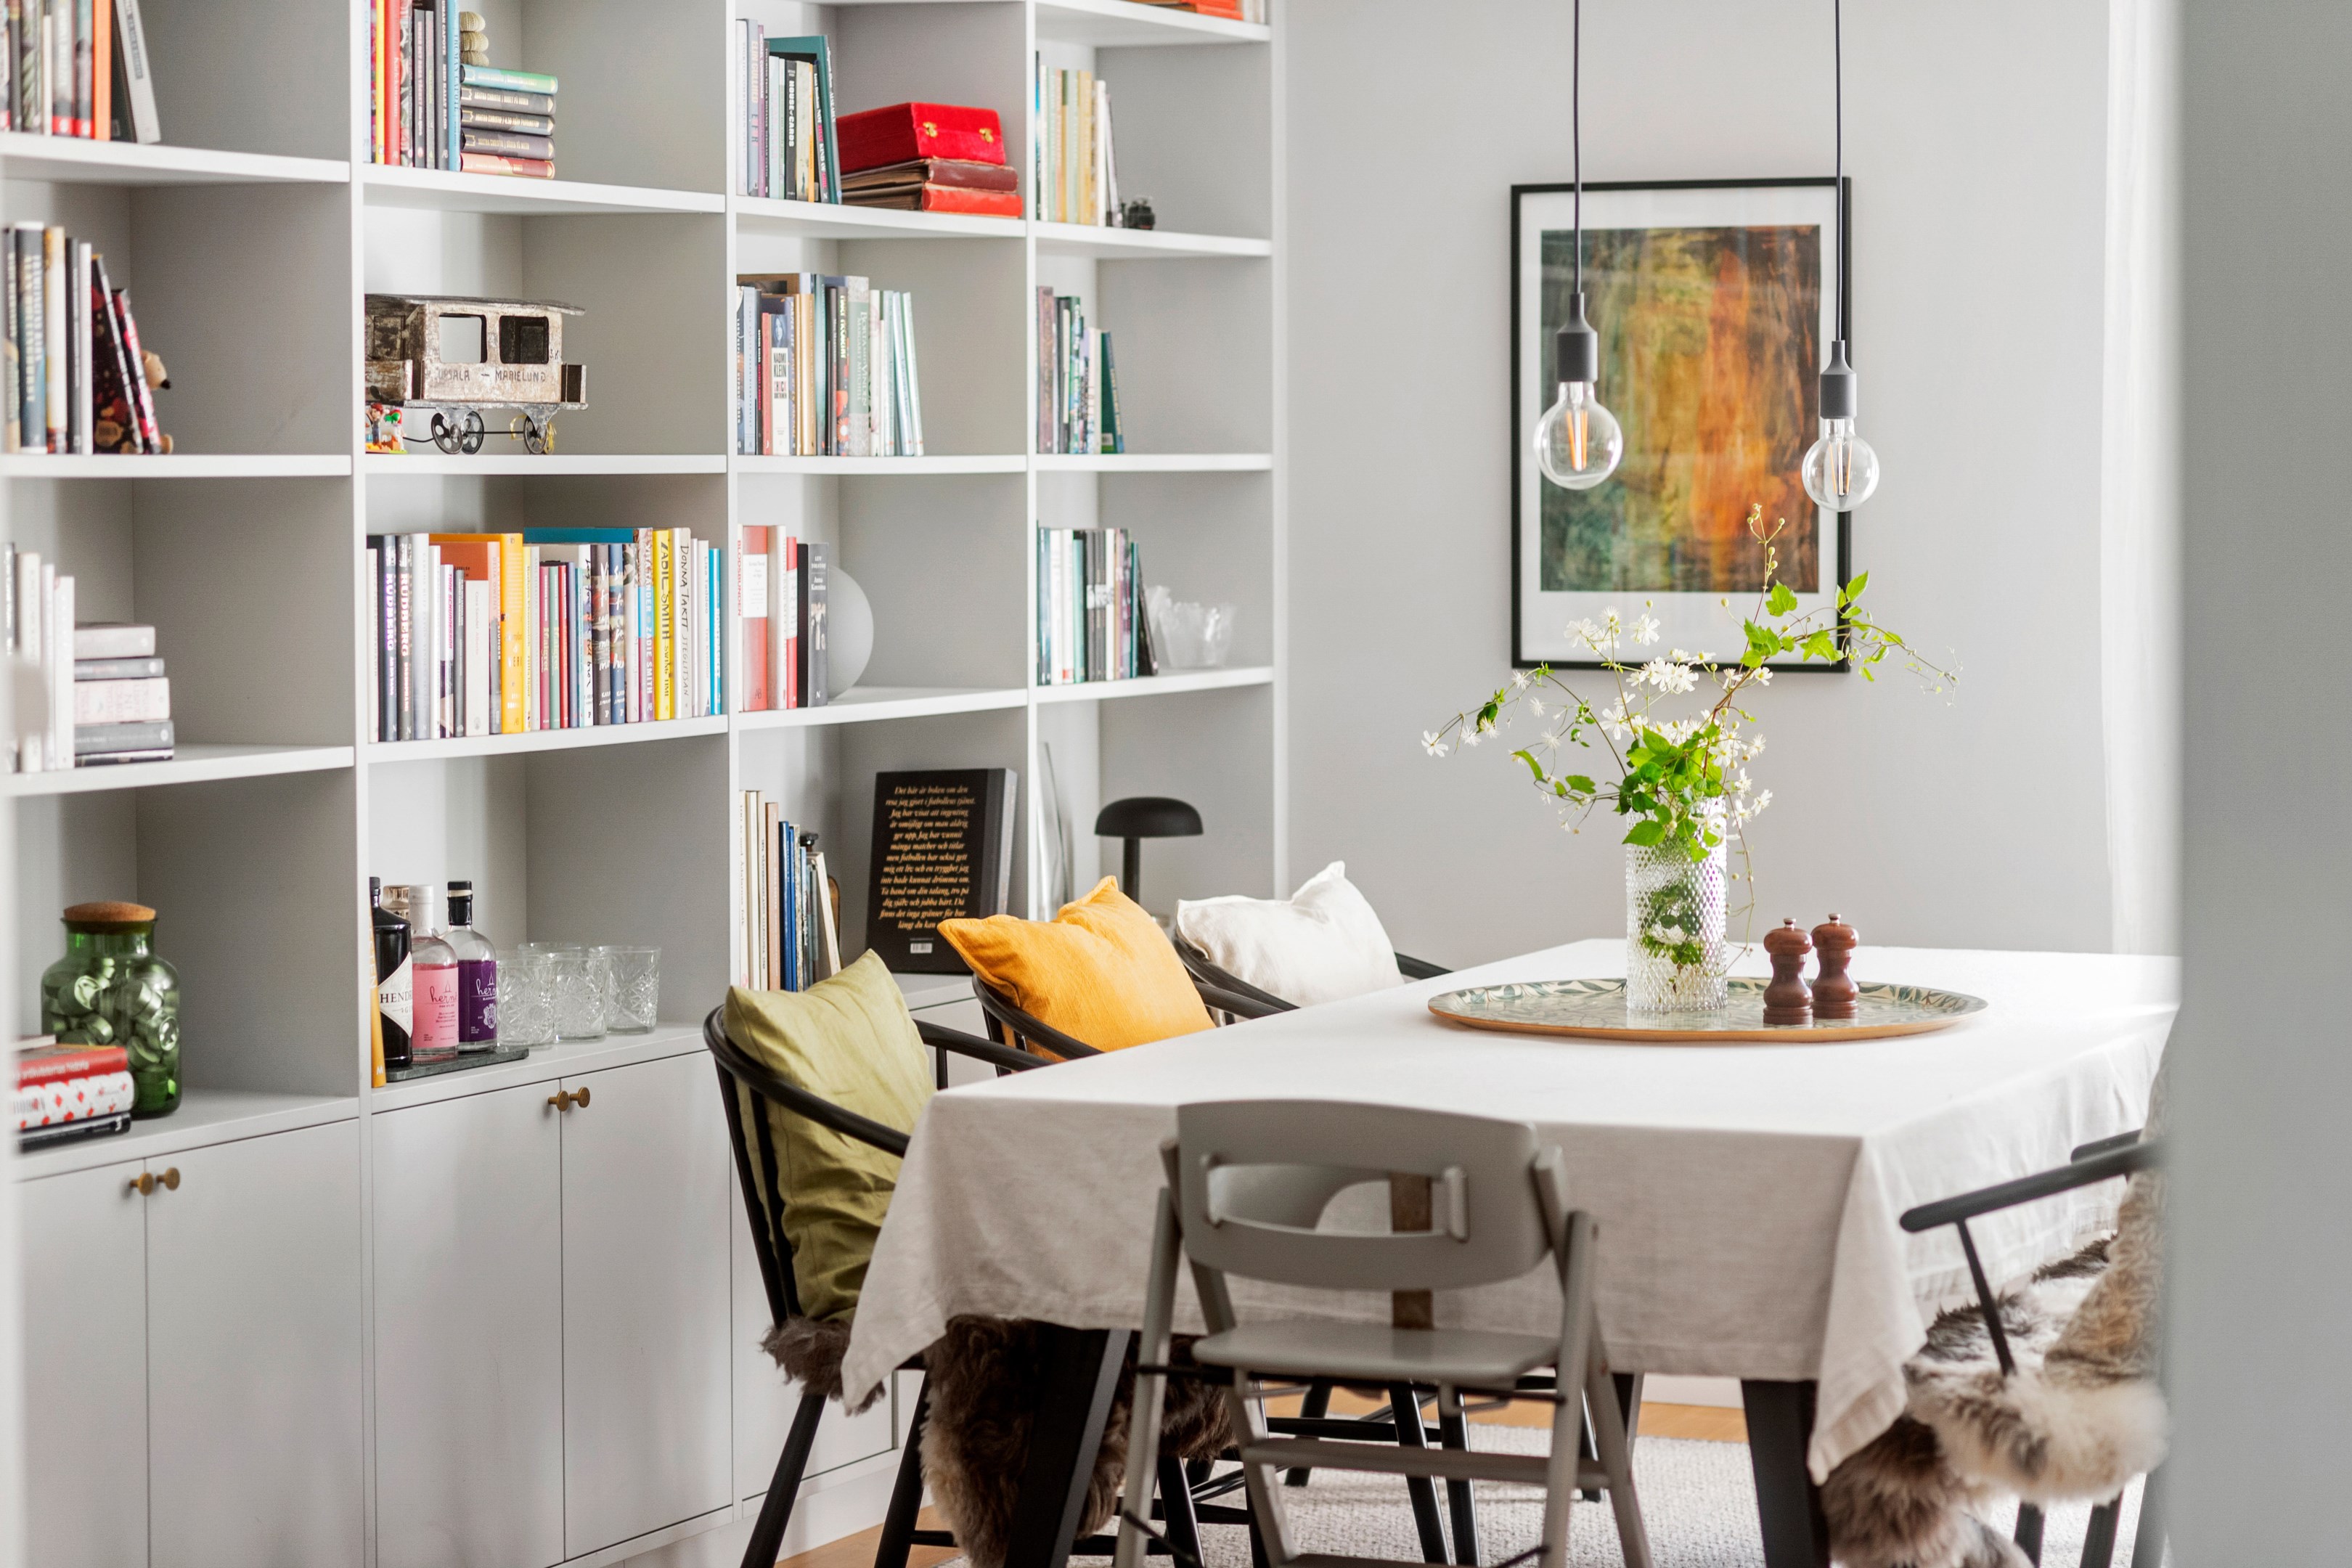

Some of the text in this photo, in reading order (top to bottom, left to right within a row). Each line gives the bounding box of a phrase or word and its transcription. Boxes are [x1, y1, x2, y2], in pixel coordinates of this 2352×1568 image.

[821, 162, 826, 172] OF
[773, 364, 787, 377] KLEIN
[680, 543, 689, 587] DONNA
[661, 593, 670, 640] SMITH
[681, 588, 690, 632] TARTT
[476, 978, 497, 997] hern
